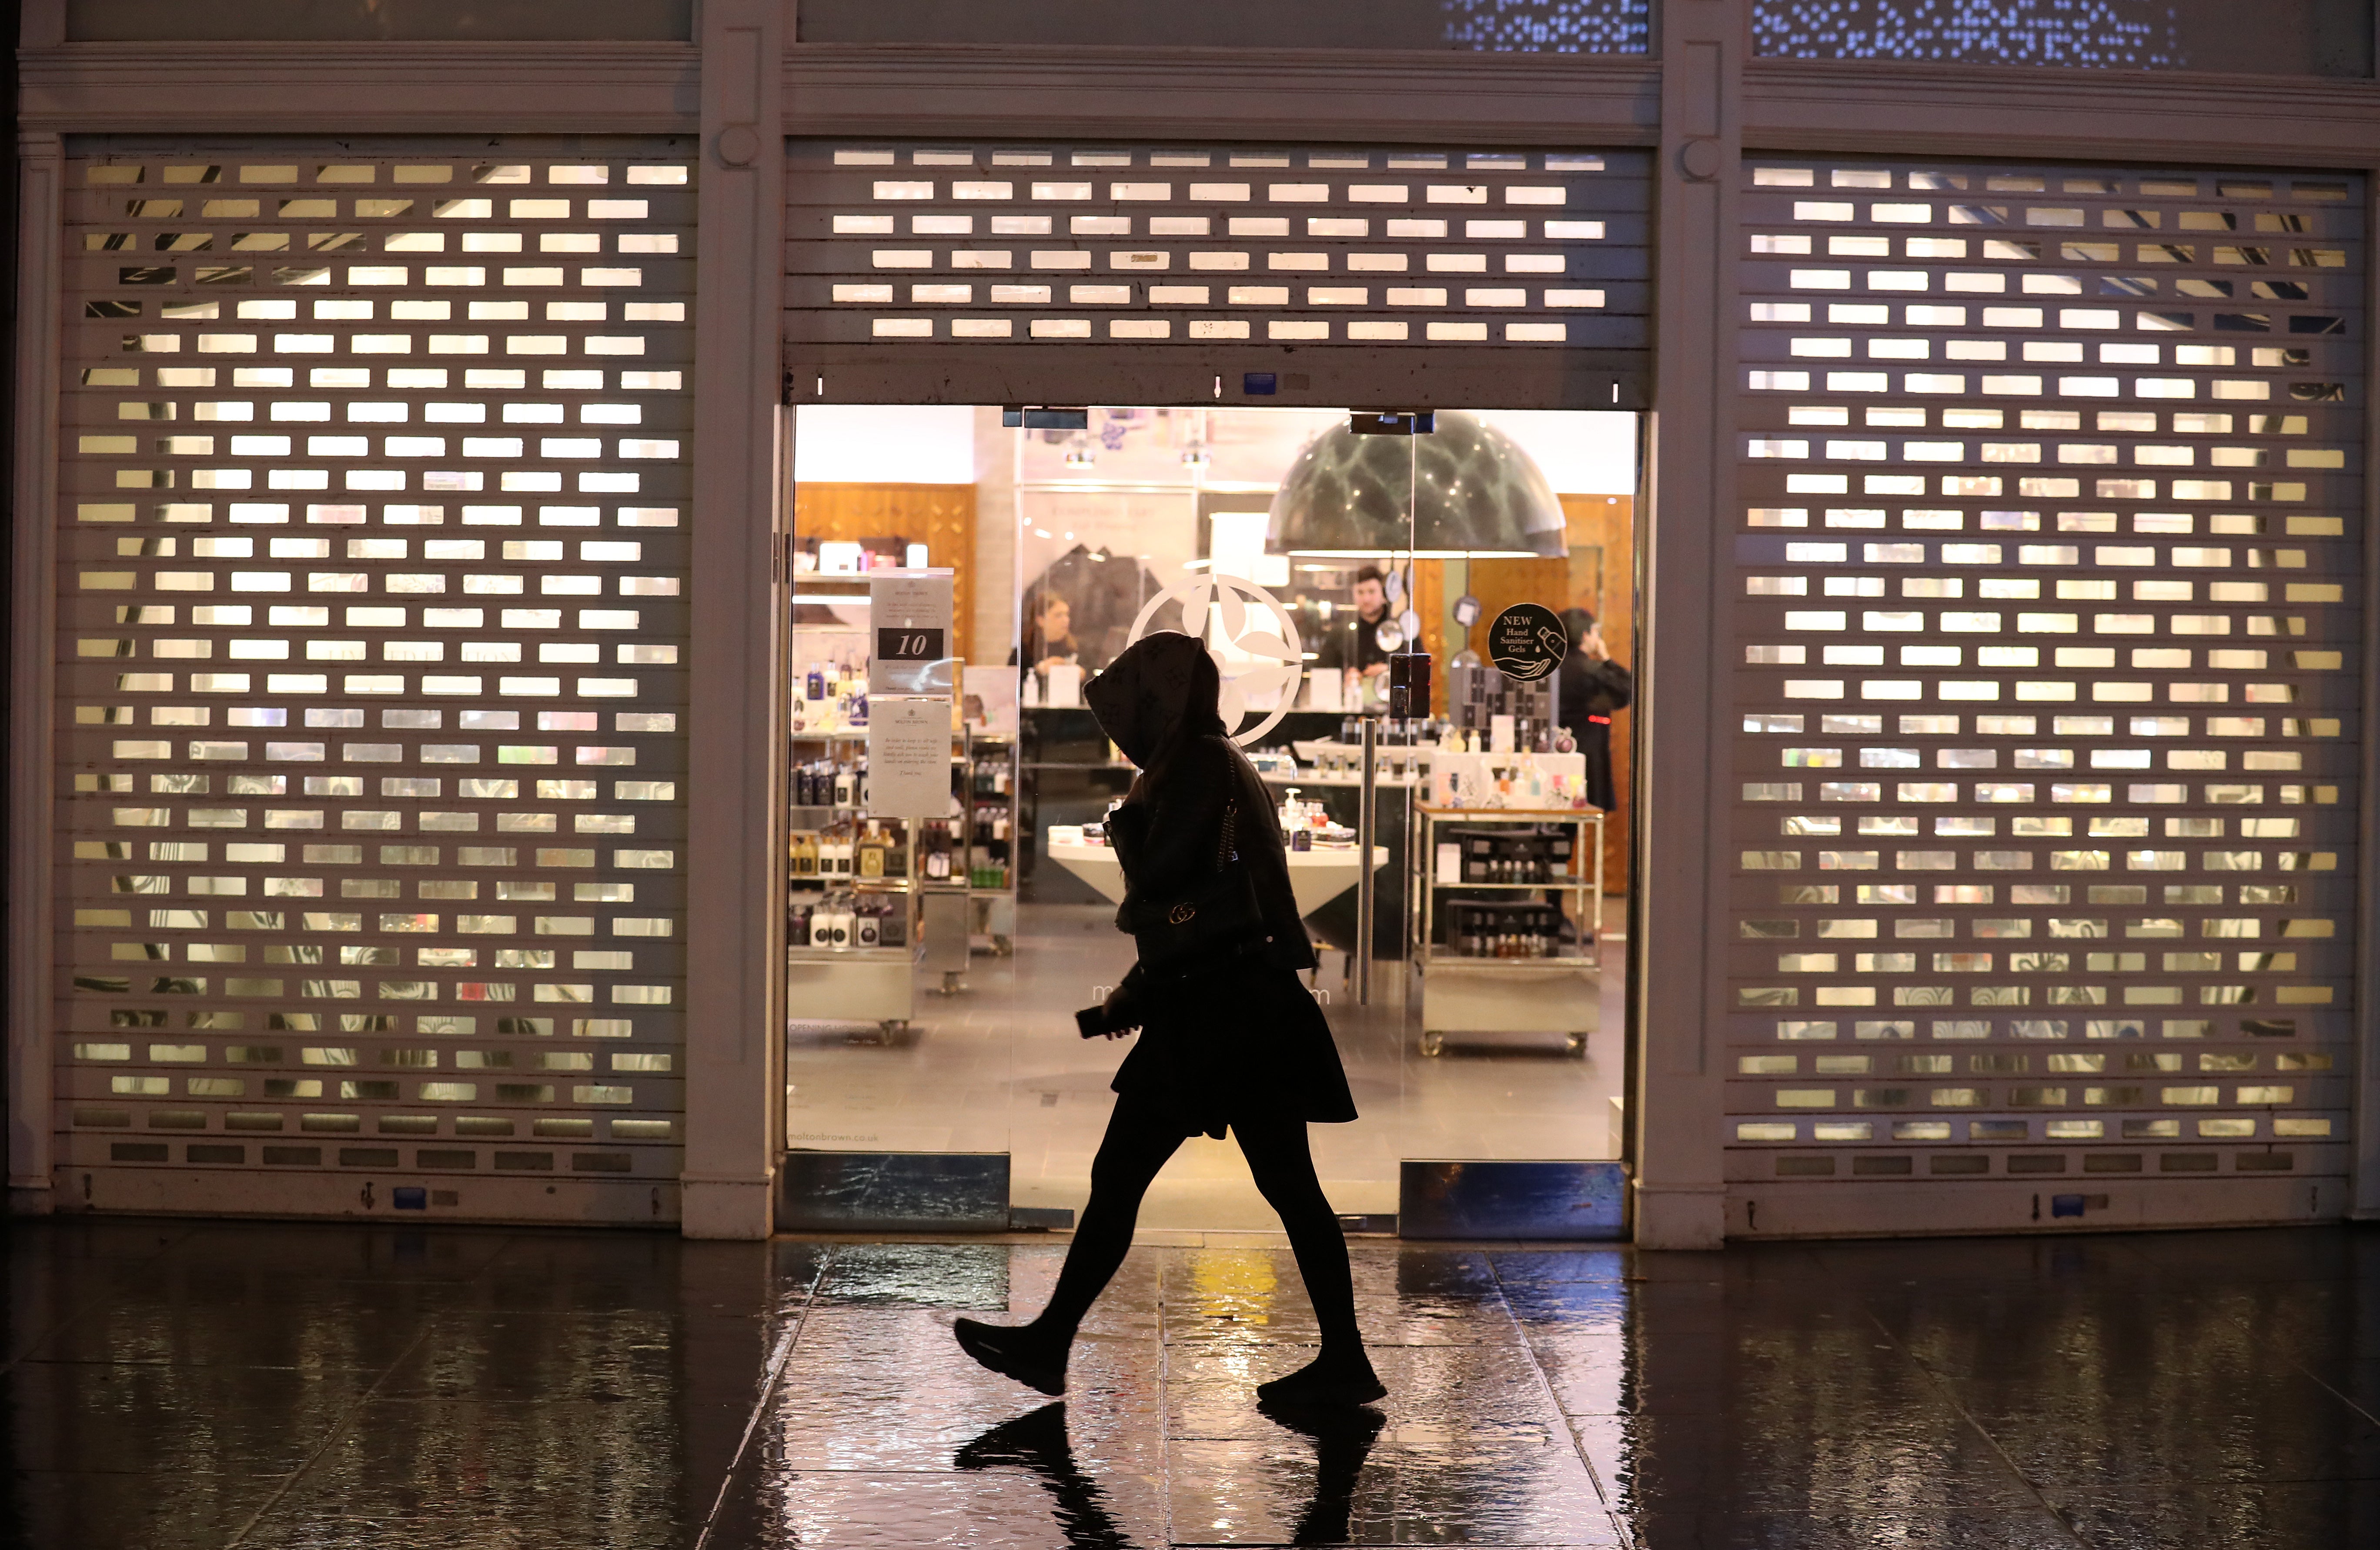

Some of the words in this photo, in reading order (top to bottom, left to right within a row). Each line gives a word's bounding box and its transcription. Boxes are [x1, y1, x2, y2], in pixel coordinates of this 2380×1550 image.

[1503, 616, 1533, 625] NEW
[896, 635, 927, 655] 10
[787, 1132, 878, 1142] moltonbrown.co.uk
